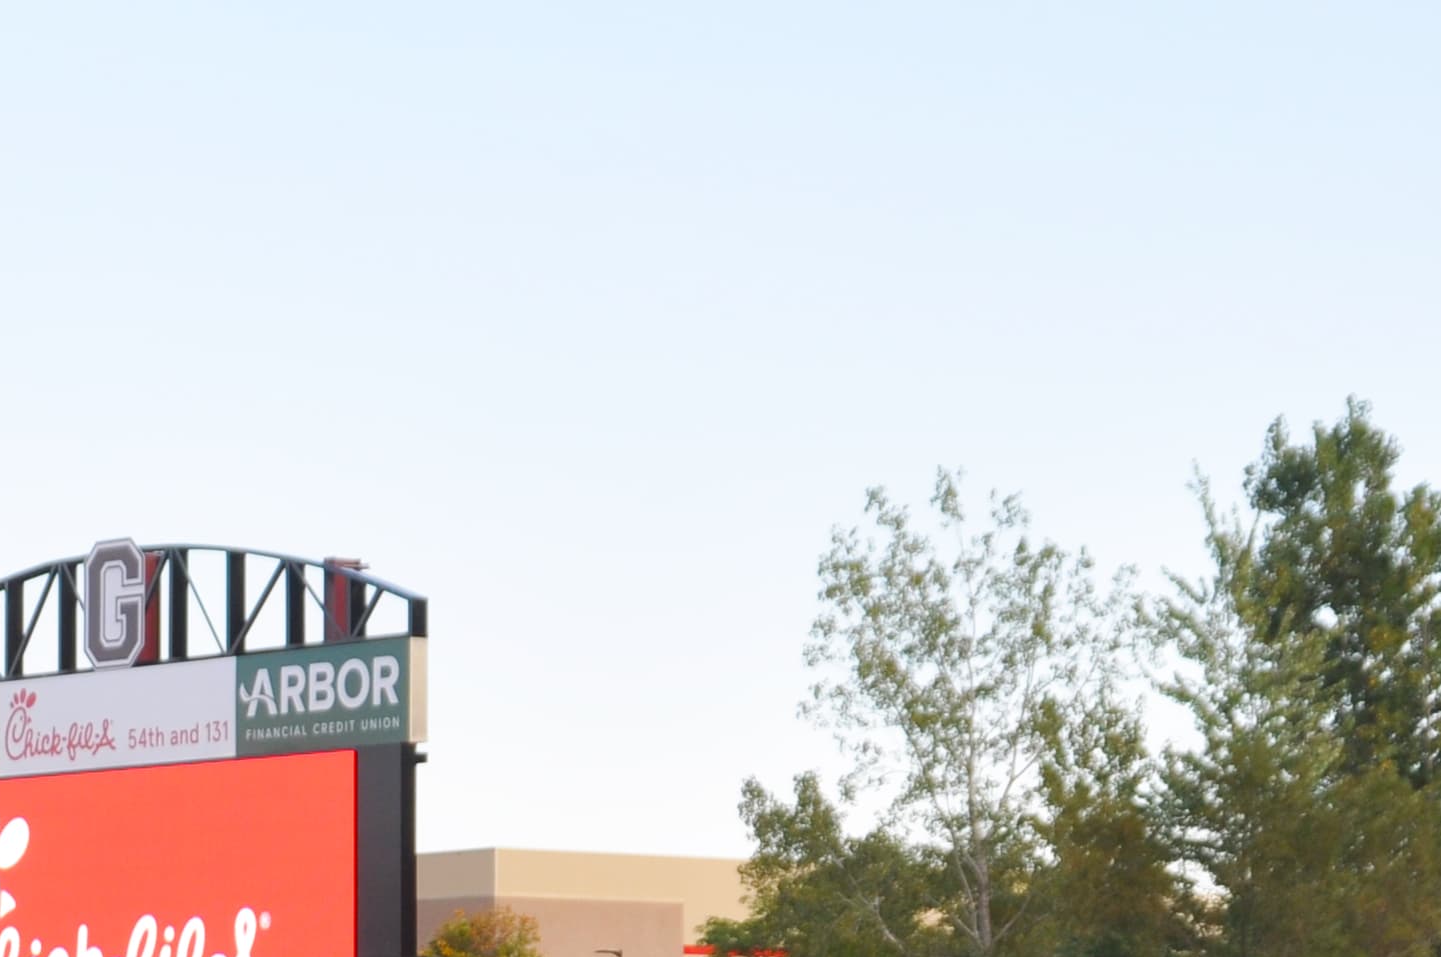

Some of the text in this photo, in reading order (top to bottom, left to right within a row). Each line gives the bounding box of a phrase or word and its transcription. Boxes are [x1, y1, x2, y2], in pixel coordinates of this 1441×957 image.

[85, 538, 146, 668] G
[240, 655, 399, 717] ARBOR
[5, 705, 229, 761] Chick-fil-A 54th and 131
[246, 717, 400, 740] FINANCIAL CREDIT UNION
